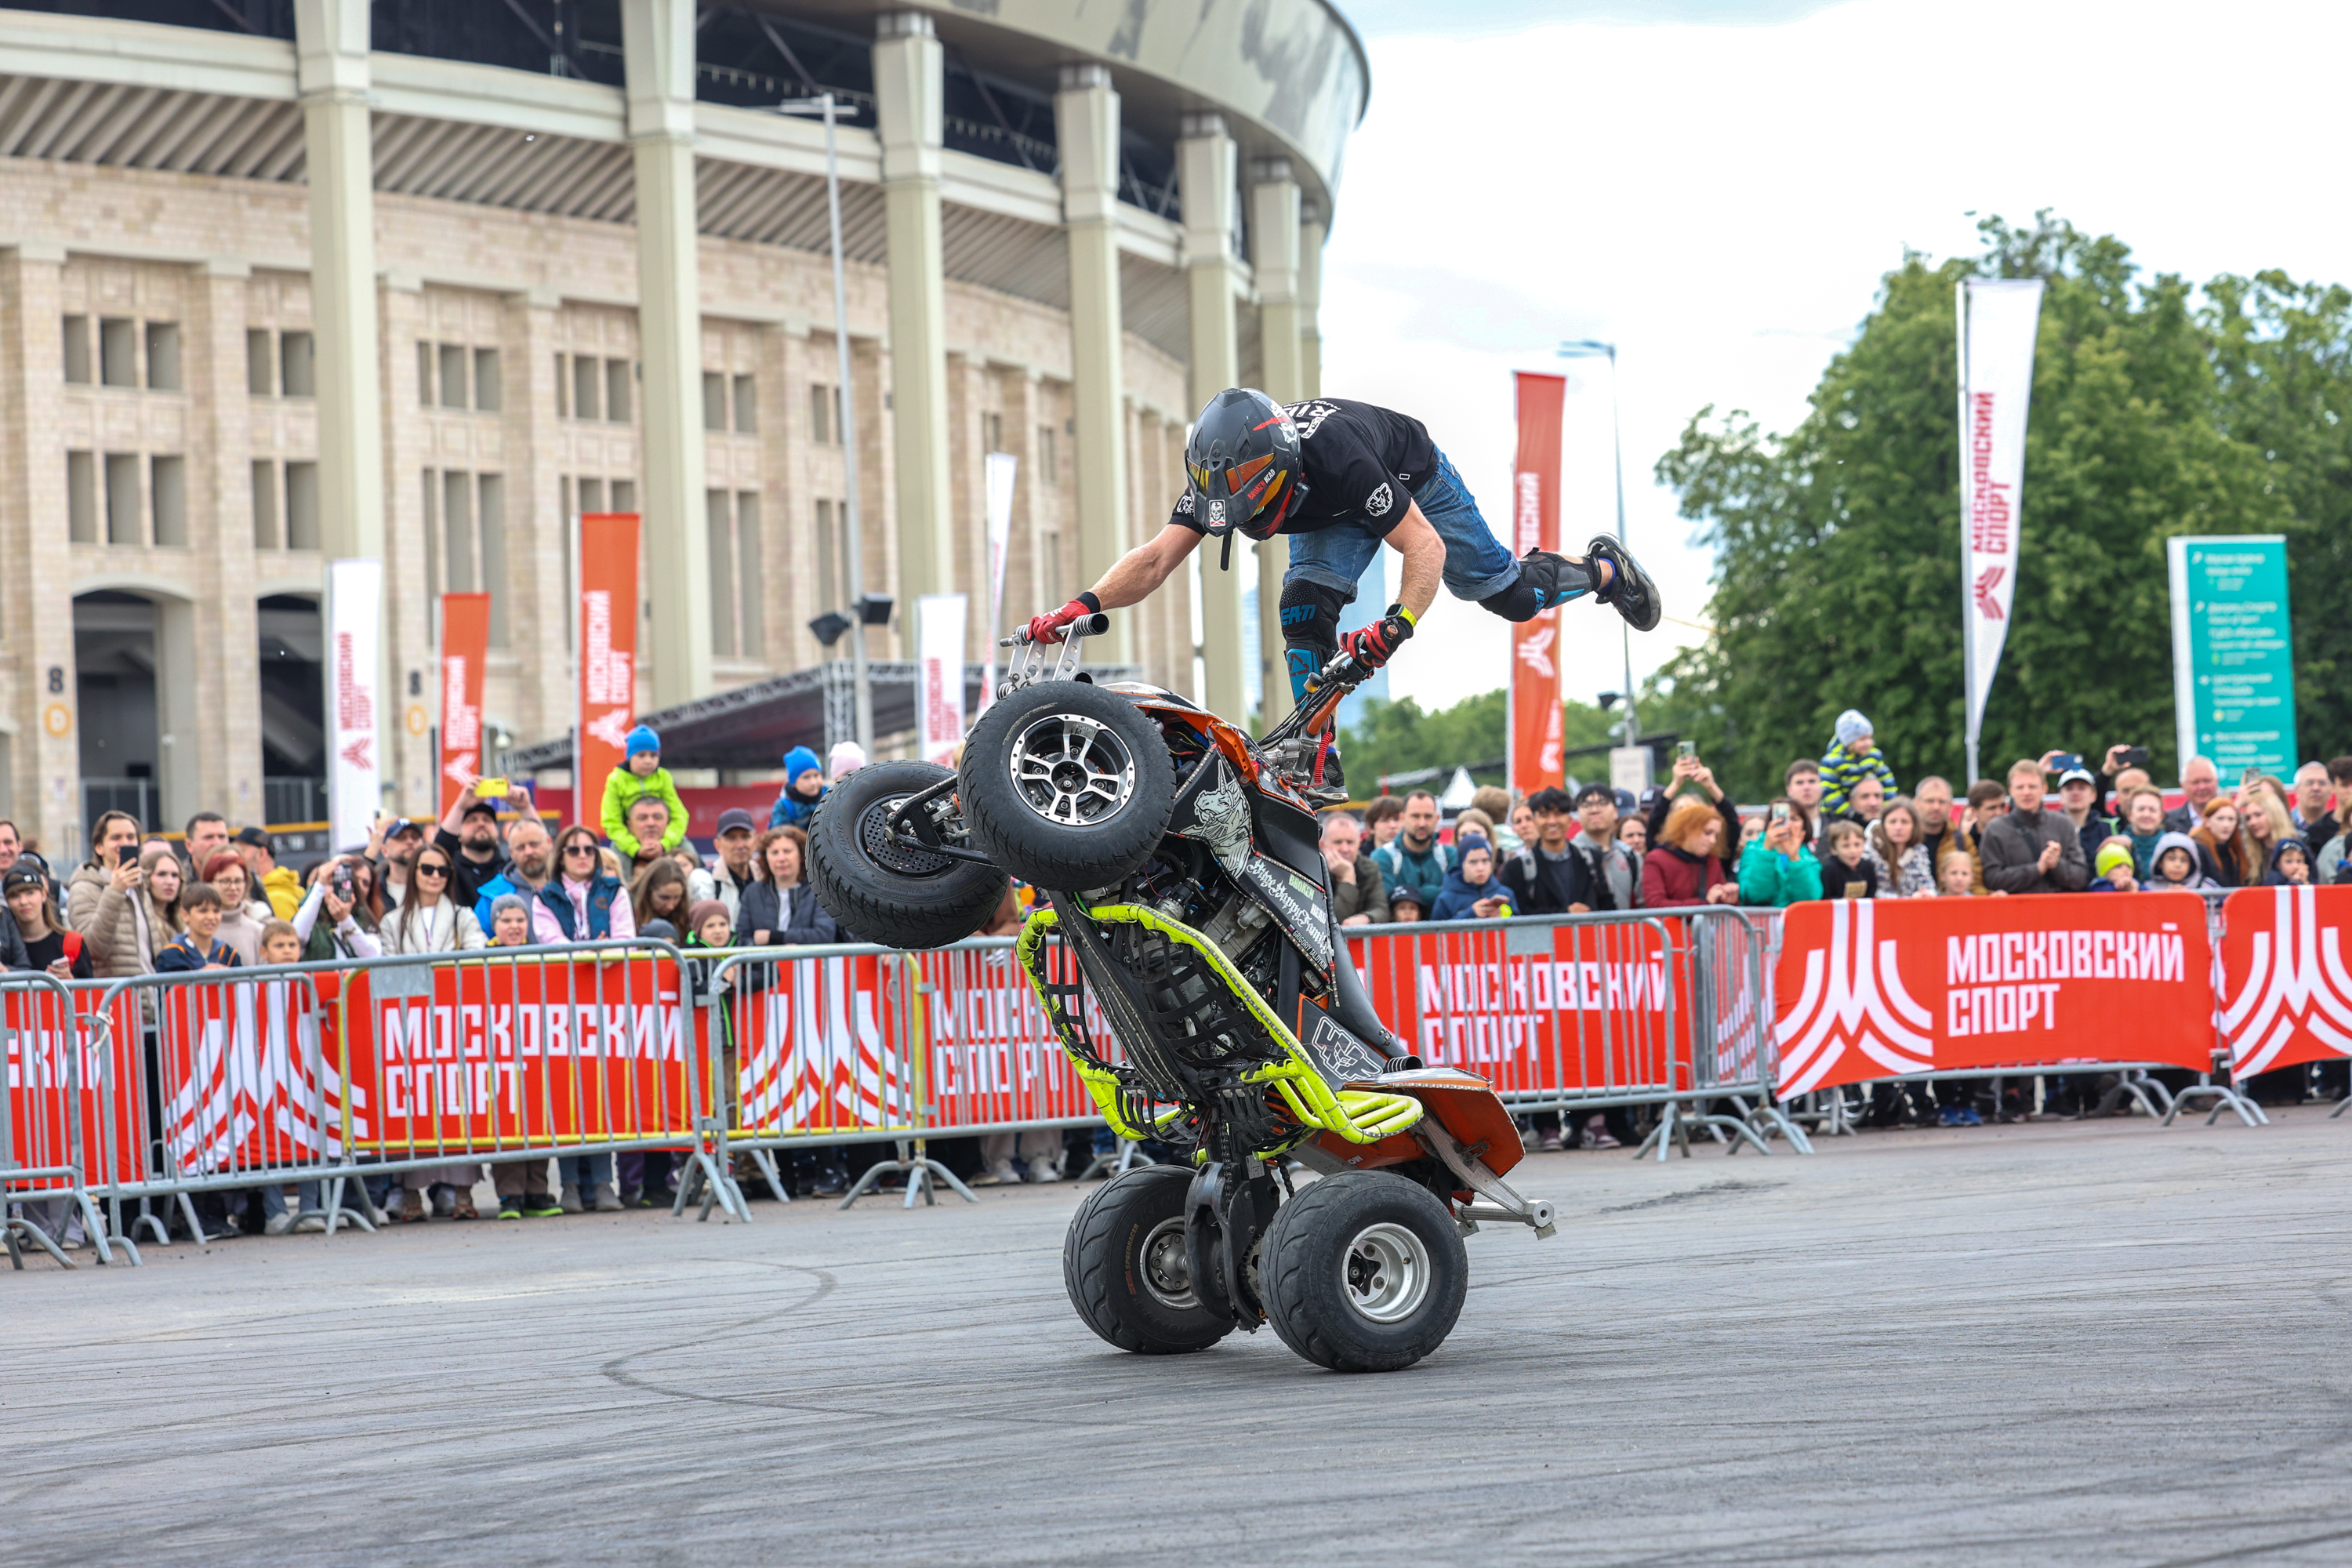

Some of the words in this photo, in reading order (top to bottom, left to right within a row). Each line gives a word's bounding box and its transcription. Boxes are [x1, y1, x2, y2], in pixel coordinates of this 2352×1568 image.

[1247, 480, 1267, 500] BROKEN
[1263, 468, 1276, 484] HEAD
[1969, 392, 1994, 552] МОСКОВСКИЙ
[1986, 481, 2012, 555] СПОРТ
[48, 667, 64, 694] 8
[1288, 874, 1315, 901] BROKEN
[1310, 903, 1327, 924] HEAD
[1293, 931, 1312, 953] GRIGORIY
[1308, 947, 1328, 971] TALDYKIN
[1947, 922, 2184, 985] МОСКОВСКИЙ
[1421, 951, 1676, 1014] МОСКОВСКИЙ
[385, 991, 685, 1062] МОСКОВСКИЙ
[1947, 983, 2060, 1037] СПОРТ
[1424, 1014, 1544, 1066] СПОРТ
[385, 1062, 528, 1118] СПОРТ
[937, 1042, 1064, 1096] СПОРТ
[1124, 1223, 1140, 1270] SPEEDRACER
[1124, 1270, 1137, 1295] KENDA
